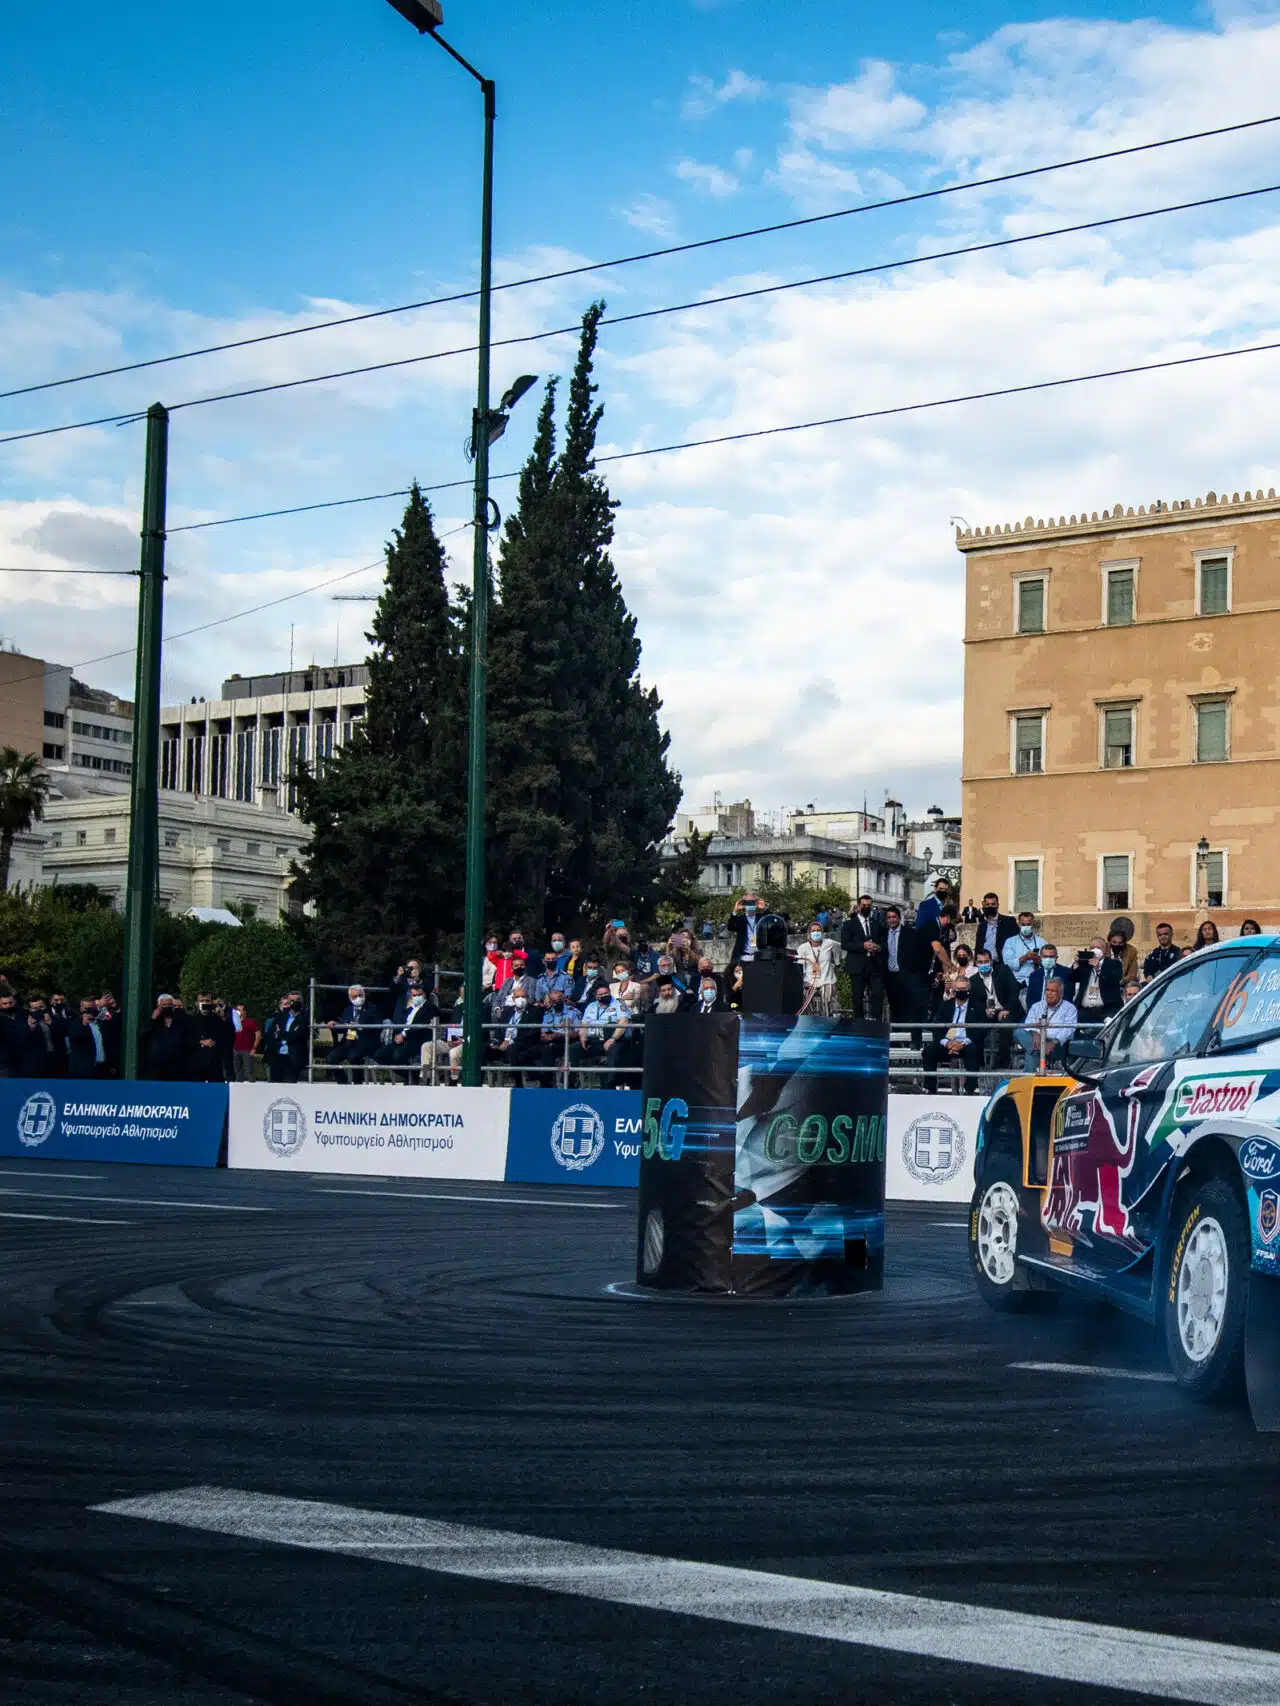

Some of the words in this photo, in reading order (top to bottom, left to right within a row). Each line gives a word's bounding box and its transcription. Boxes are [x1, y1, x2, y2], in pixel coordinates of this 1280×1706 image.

[1213, 970, 1259, 1028] 16
[63, 1103, 117, 1118] ΕΛΛΗΝΙΚΗ
[118, 1105, 189, 1120] ΔΗΜΟΚΡΑΤΙΑ
[1188, 1080, 1256, 1115] Castrol
[61, 1121, 120, 1139] Υφυπουργείο
[121, 1123, 178, 1140] Αθλητισμού
[314, 1111, 377, 1126] ΕΛΛΗΝΙΚΗ
[380, 1113, 464, 1128] ΔΗΜΟΚΡΑΤΙΑ
[643, 1097, 689, 1160] 5G
[314, 1131, 385, 1149] Υφυπουργείο
[388, 1134, 454, 1152] Αθλητισμού
[1169, 1203, 1201, 1303] SCORPION
